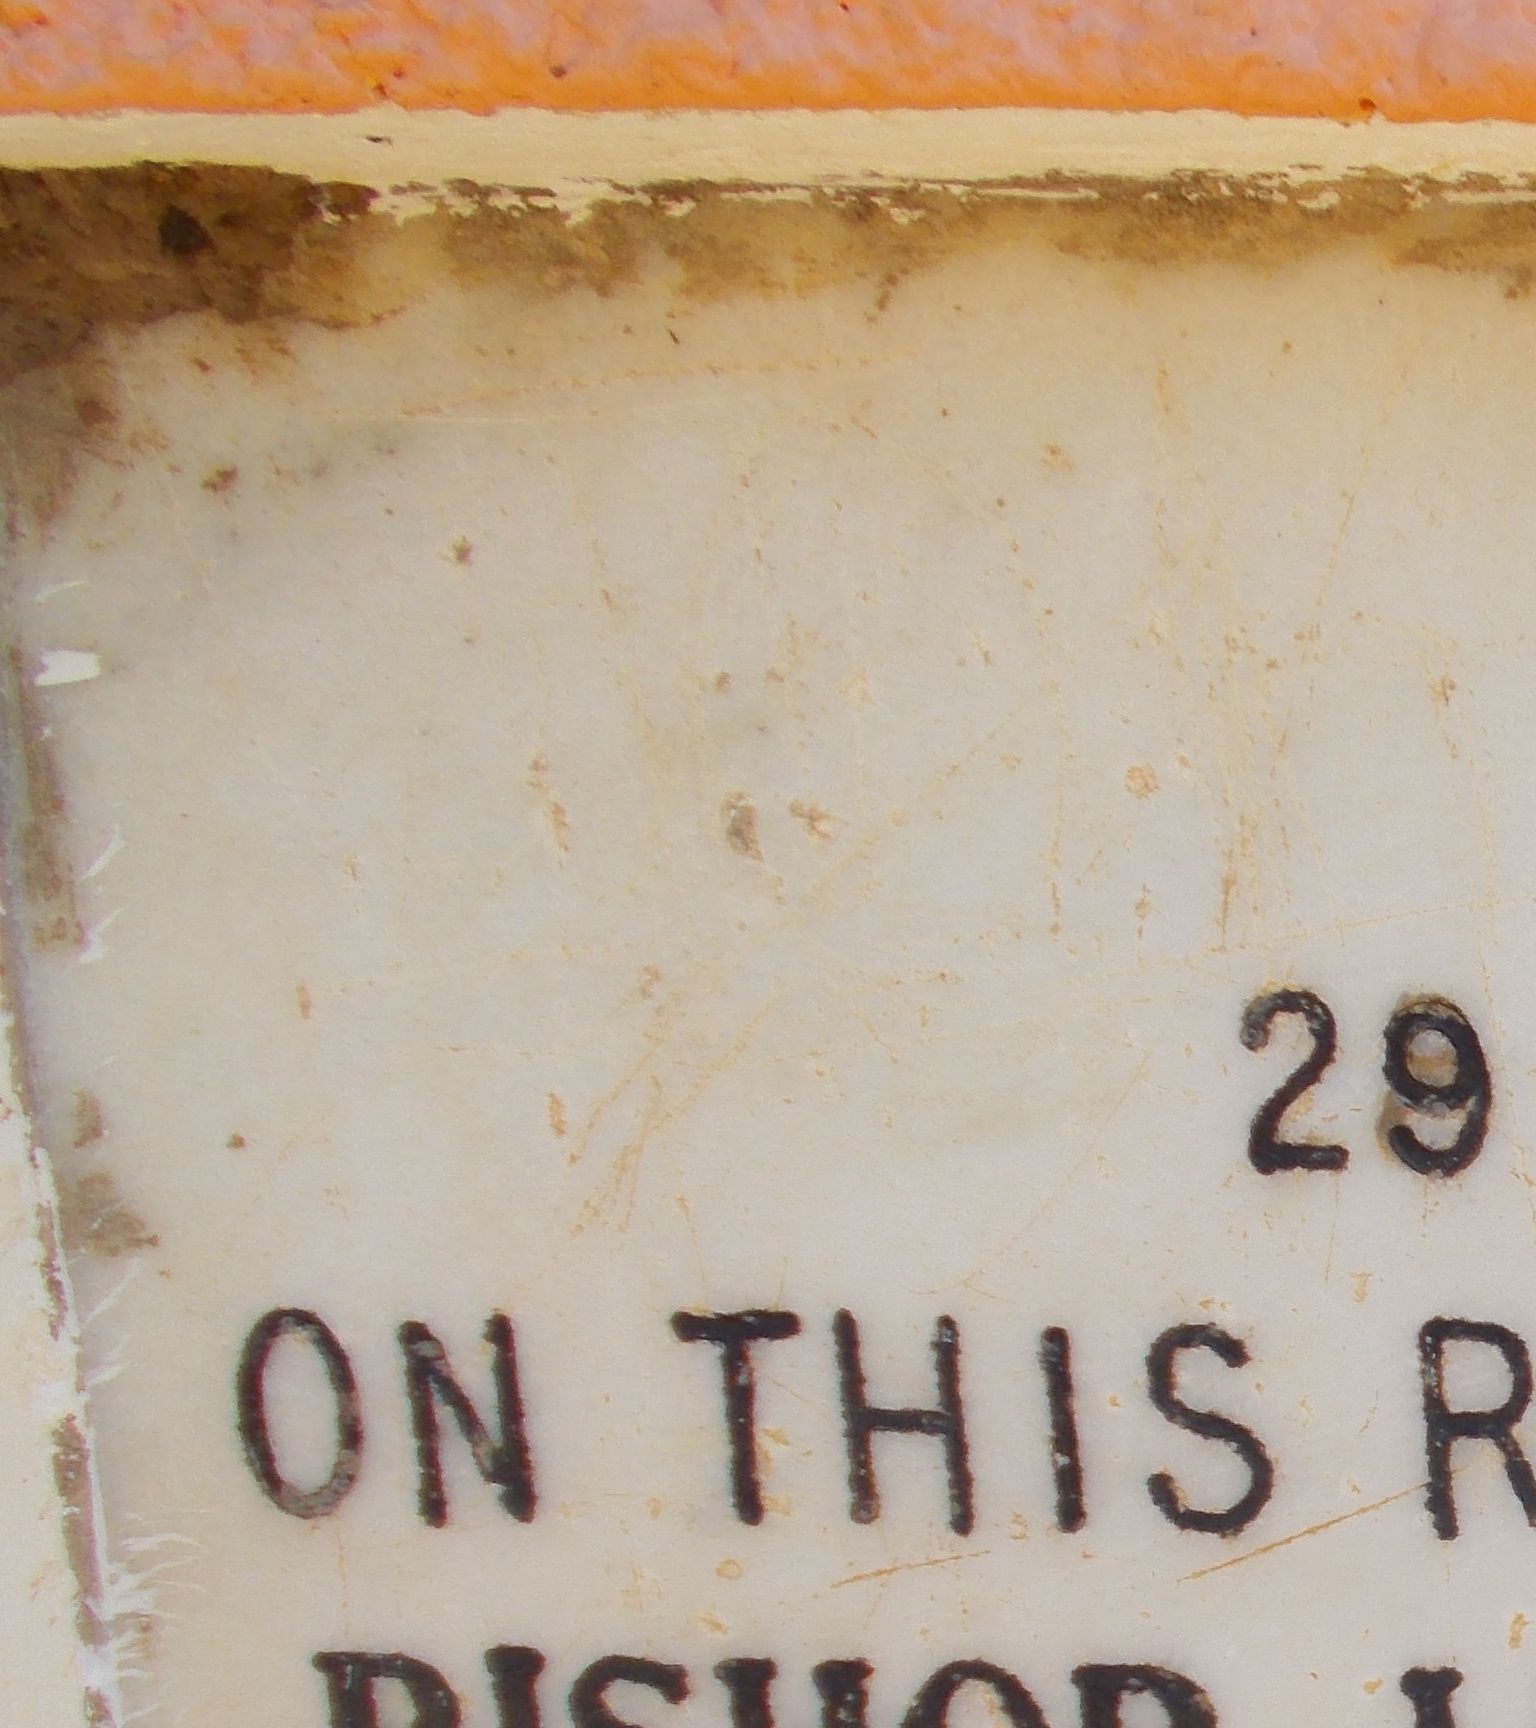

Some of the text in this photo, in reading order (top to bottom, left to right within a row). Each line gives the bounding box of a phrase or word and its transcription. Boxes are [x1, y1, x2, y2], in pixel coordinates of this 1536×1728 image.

[1239, 987, 1495, 1182] 29
[234, 1307, 540, 1529] ON
[668, 1307, 1275, 1540] THIS
